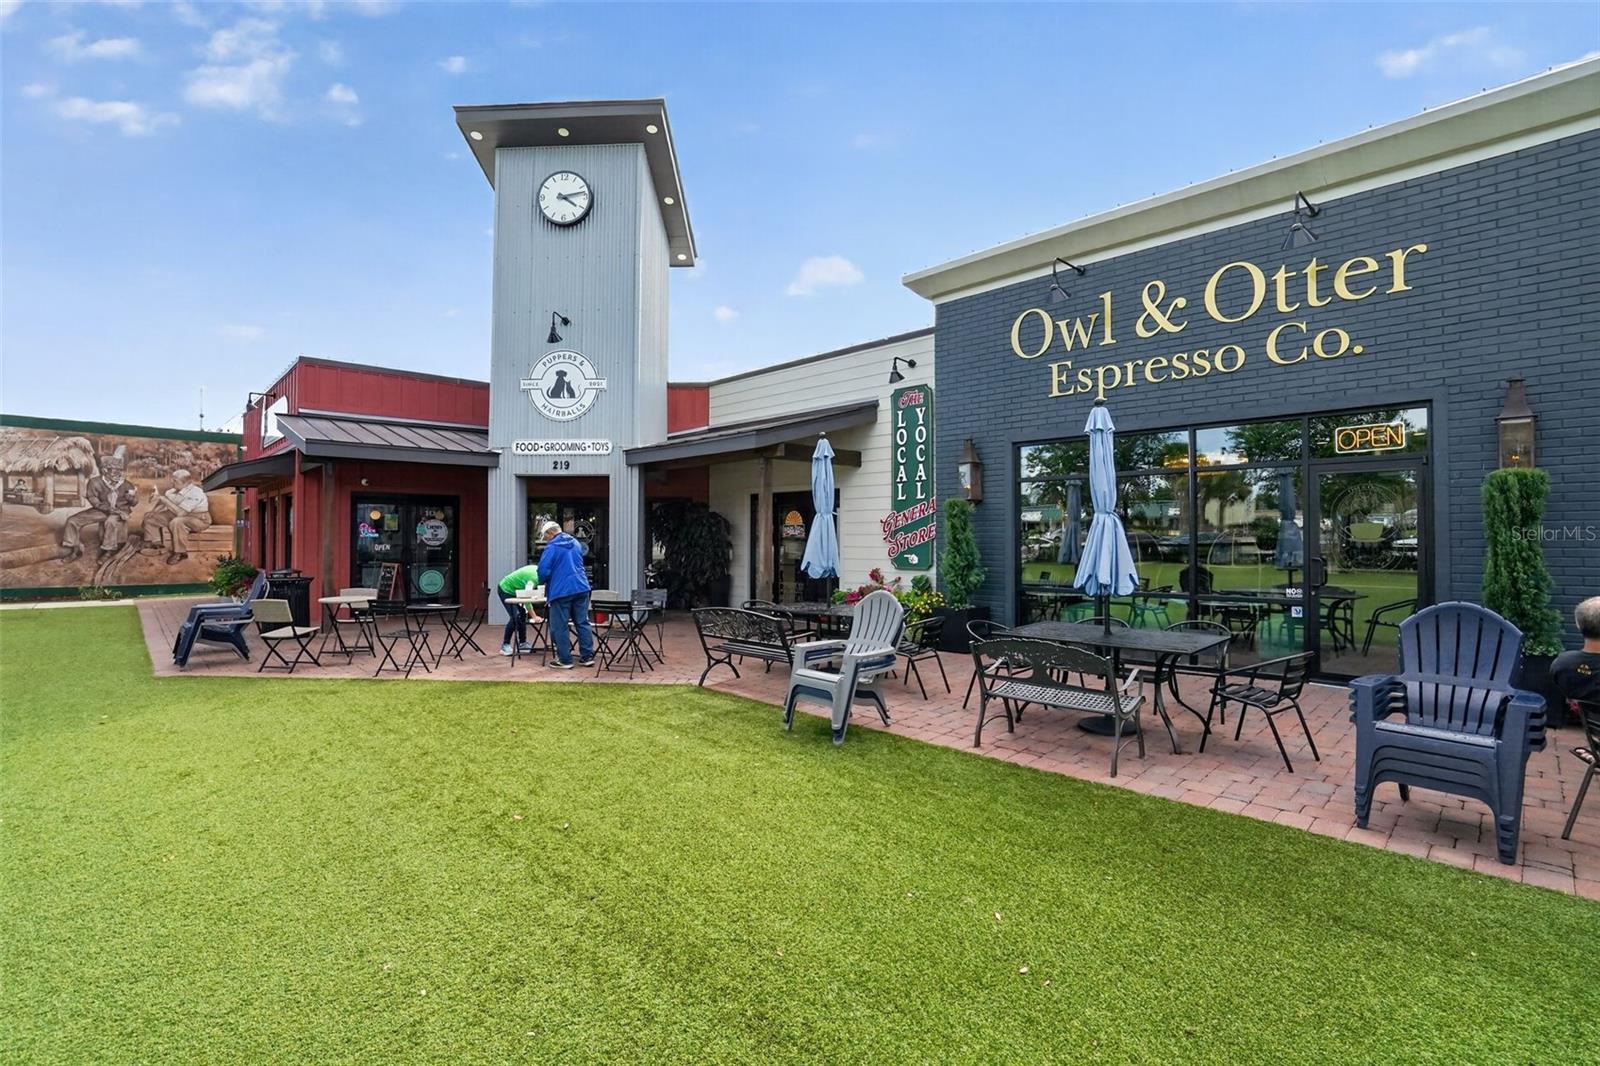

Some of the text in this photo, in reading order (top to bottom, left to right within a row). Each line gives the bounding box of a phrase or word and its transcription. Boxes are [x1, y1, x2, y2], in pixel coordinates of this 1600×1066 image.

[560, 173, 569, 181] 12
[540, 194, 545, 202] 9
[583, 192, 589, 200] 3
[1010, 243, 1428, 359] Owl & Otter
[542, 354, 577, 367] PUPPERS
[1047, 321, 1363, 401] Espresso Co.
[541, 403, 586, 417] HAIRBALLS
[1339, 425, 1402, 449] OPEN
[515, 442, 610, 452] FOOD GROOMING TOYS
[915, 407, 927, 499] YOCAL
[896, 410, 908, 500] LOCAL
[552, 460, 570, 470] 219
[880, 496, 937, 541] GENERA
[374, 543, 391, 551] OPEN
[888, 523, 937, 559] STORE
